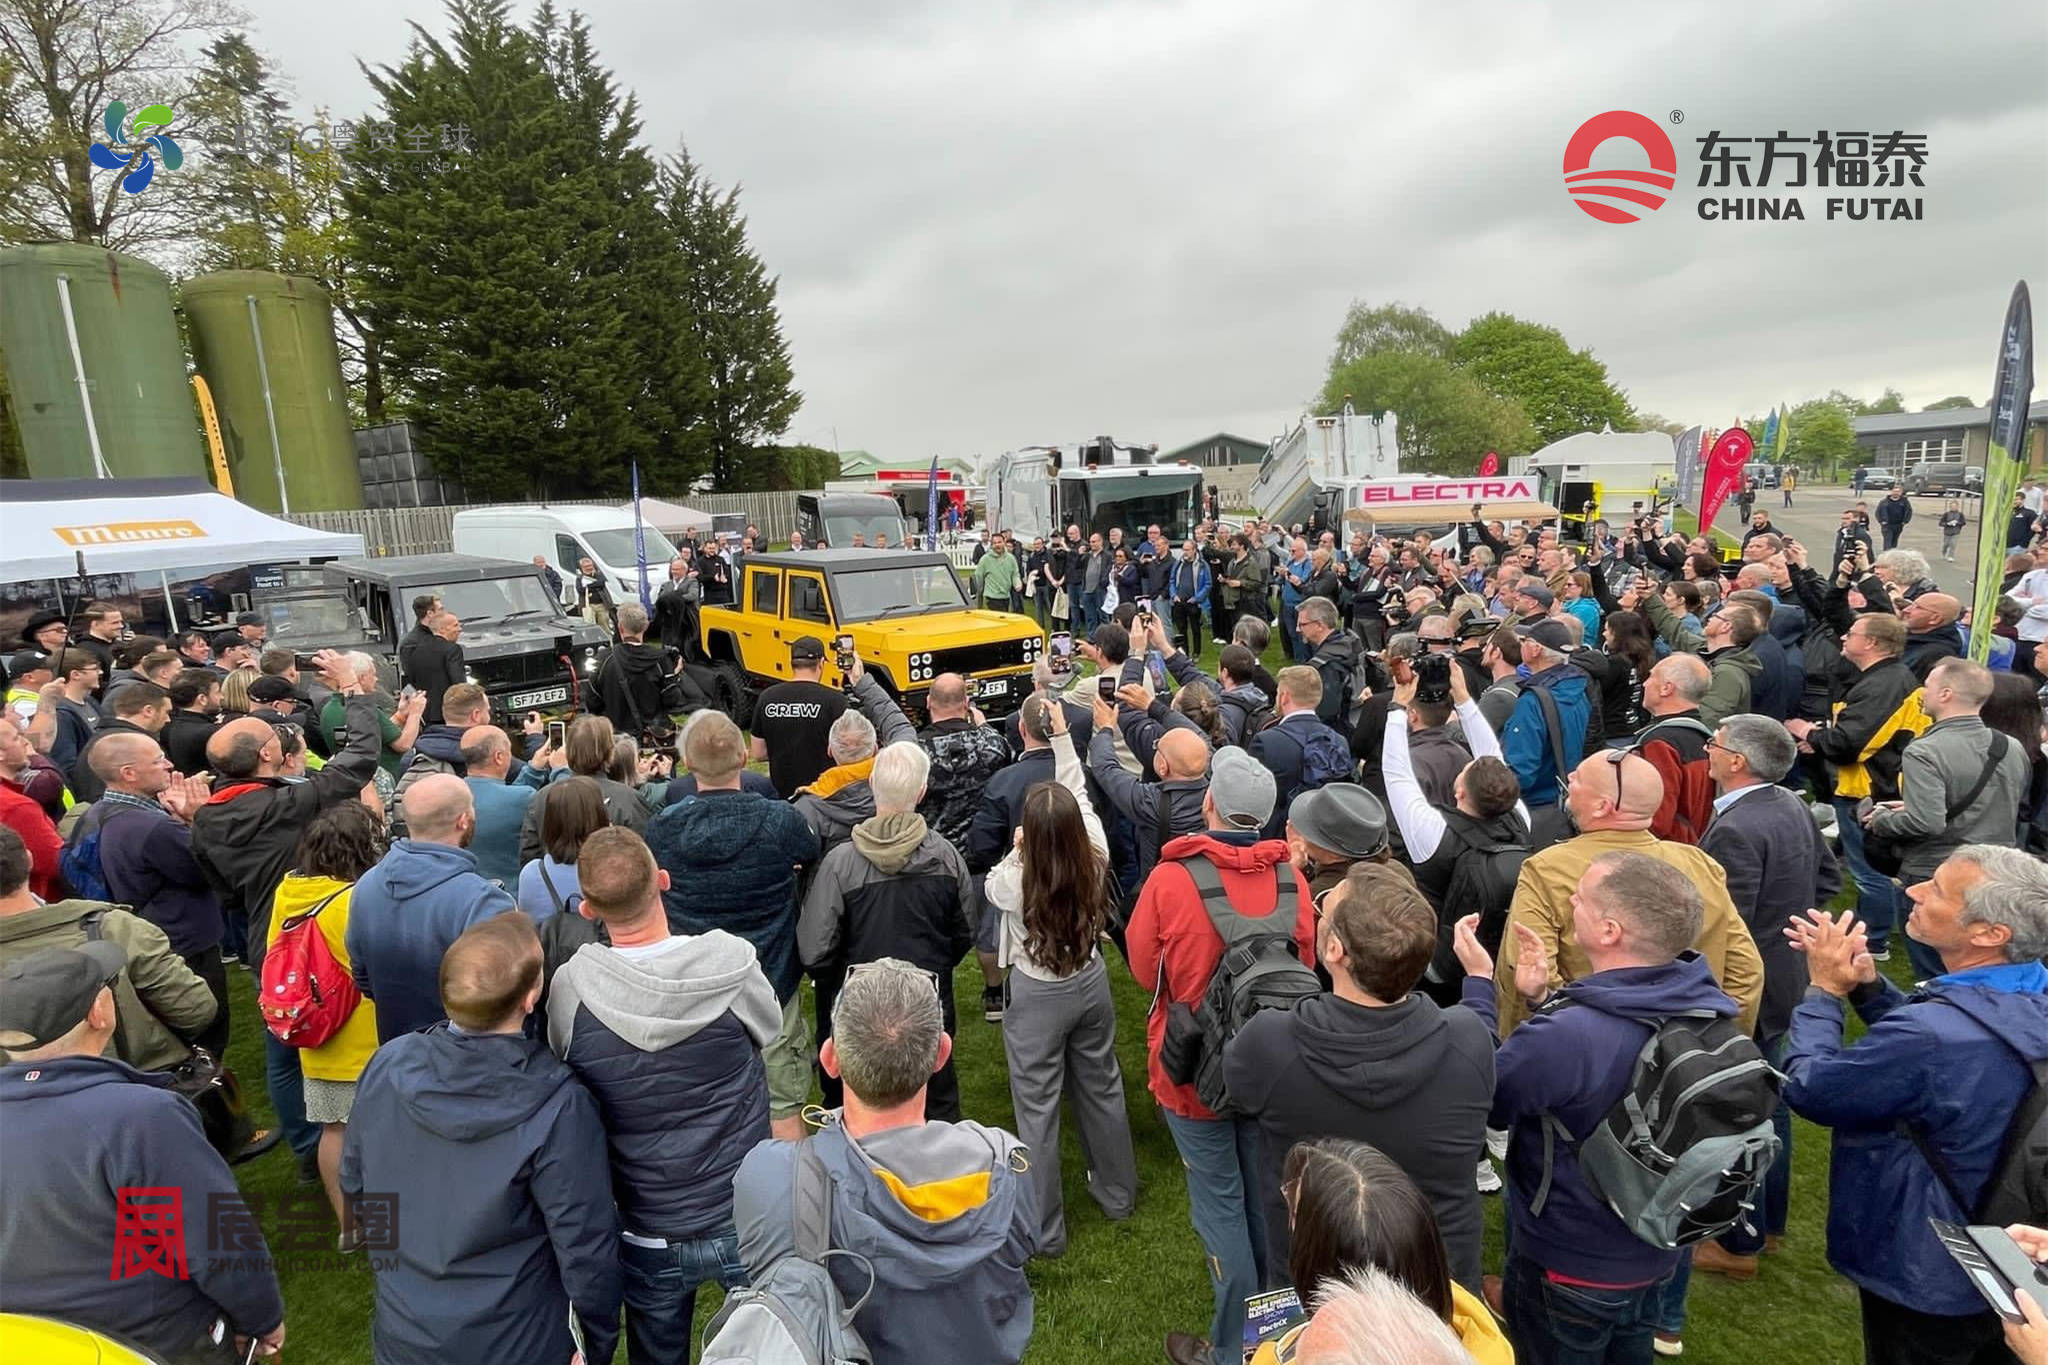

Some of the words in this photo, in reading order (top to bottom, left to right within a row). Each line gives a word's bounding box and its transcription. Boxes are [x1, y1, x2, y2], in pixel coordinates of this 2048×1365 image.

[1364, 482, 1531, 503] ELECTRA
[71, 526, 193, 543] Munro
[514, 693, 542, 706] SF72
[544, 689, 564, 701] EFZ
[765, 703, 821, 718] CREW
